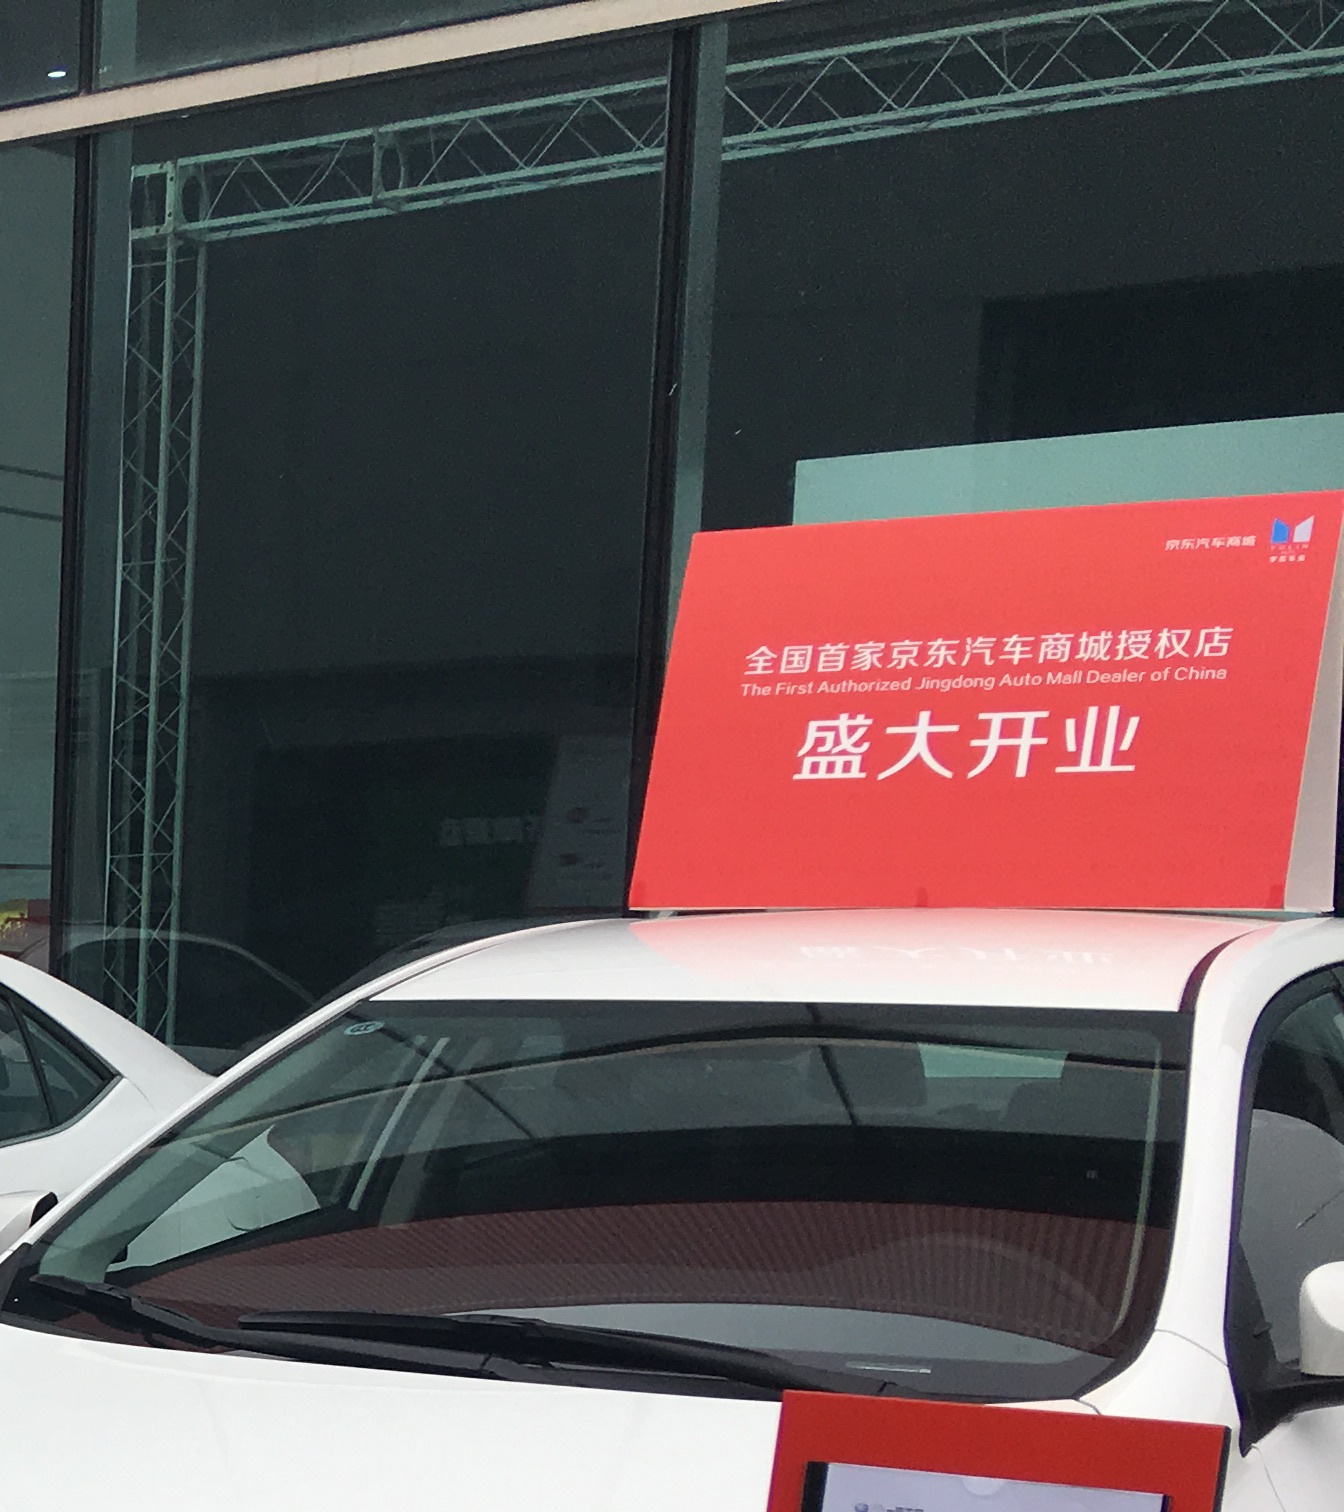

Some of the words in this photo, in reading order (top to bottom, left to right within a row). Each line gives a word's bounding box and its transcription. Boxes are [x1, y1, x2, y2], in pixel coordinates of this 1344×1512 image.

[1165, 535, 1256, 550] 京东汽车商城
[744, 626, 1233, 676] 全国首家京东汽车商城授权店
[740, 682, 771, 697] The
[775, 680, 813, 696] First
[817, 677, 911, 694] Authorized
[914, 674, 995, 695] Jingdong
[999, 672, 1042, 688] Auto
[1046, 671, 1082, 687] Mall
[1086, 668, 1146, 685] Dealer
[1150, 667, 1172, 683] of
[1174, 665, 1227, 682] China
[793, 706, 1140, 780] 盛大开业
